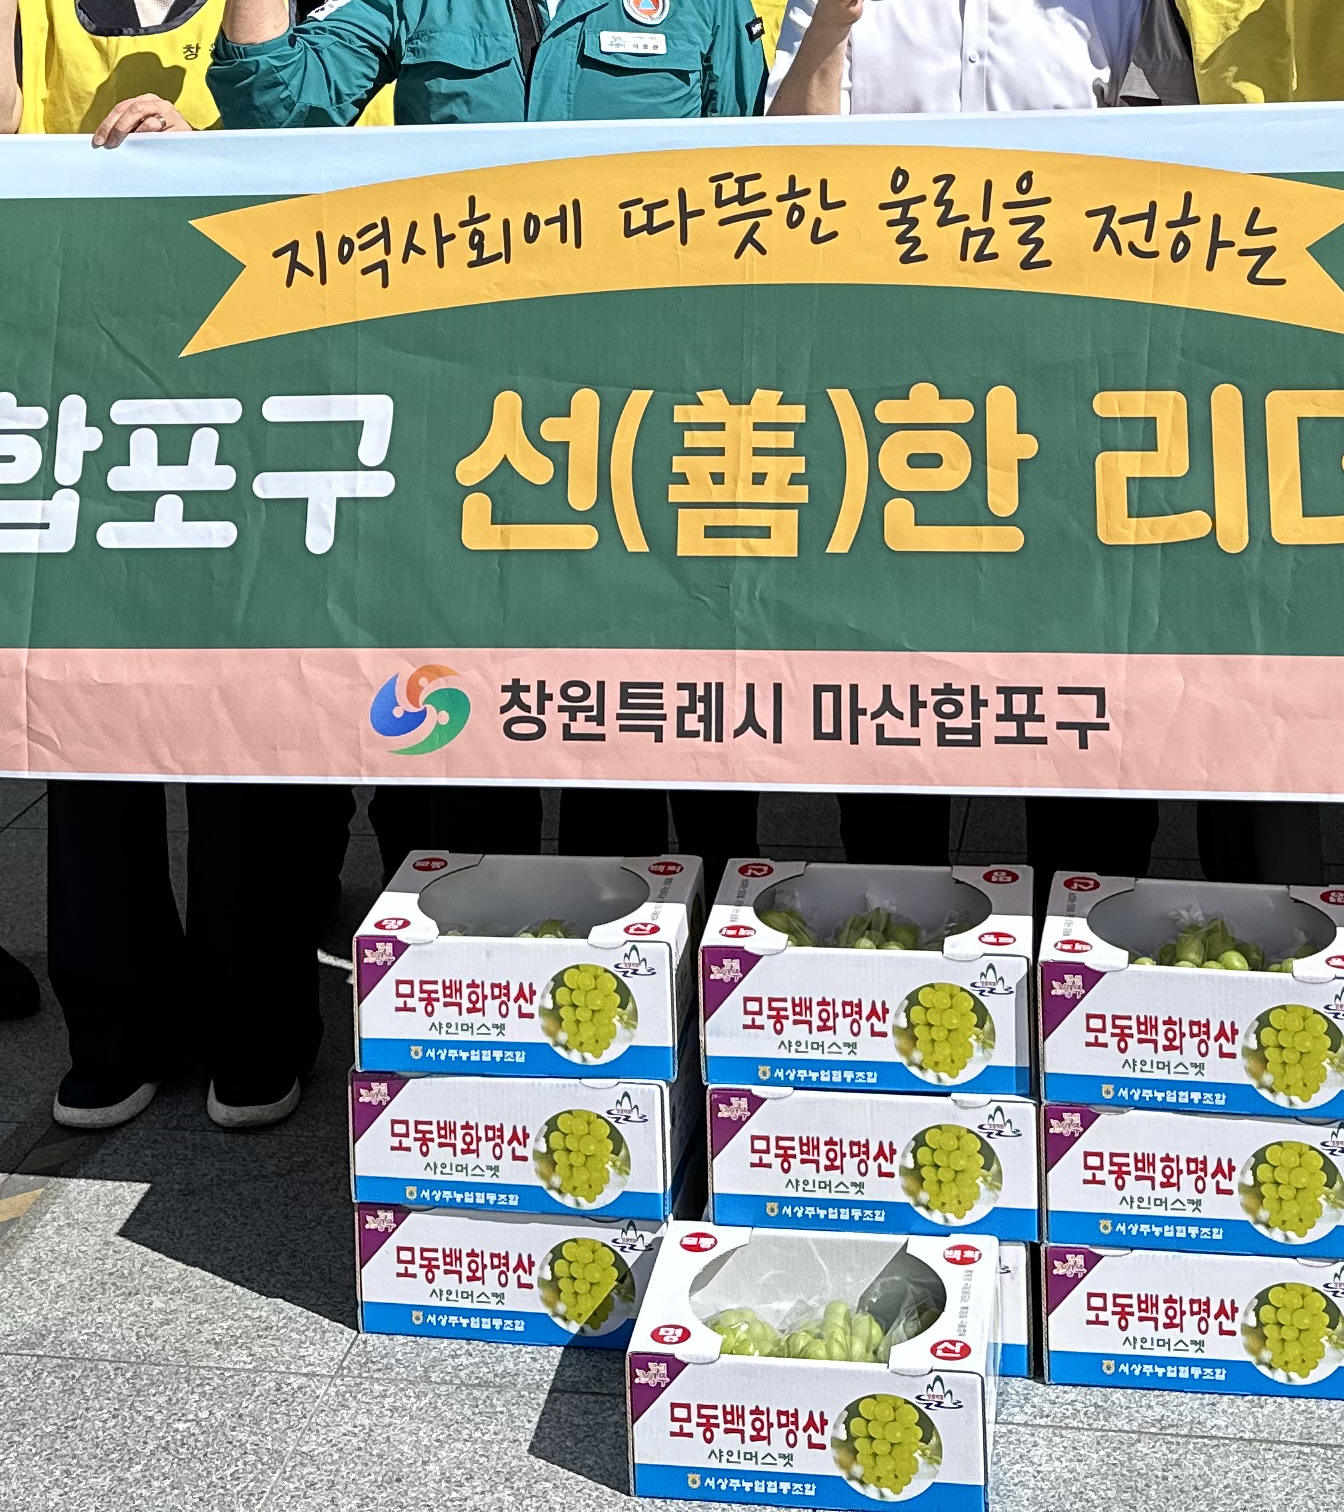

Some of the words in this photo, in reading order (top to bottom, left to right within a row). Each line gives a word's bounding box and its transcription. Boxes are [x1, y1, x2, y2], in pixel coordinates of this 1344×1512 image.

[268, 193, 584, 290] 지역사회에
[618, 169, 850, 260] 따뜻한
[875, 164, 1056, 274] 울림을
[1084, 189, 1288, 290] 전하는
[450, 381, 1043, 559] 선(善)한
[498, 676, 783, 748] 창원특례시
[812, 676, 1112, 752] 마산합포구
[393, 976, 537, 1020] 모동백화명산
[741, 995, 890, 1039] 모동백화명산
[1083, 1012, 1240, 1060] 모동백화명산
[388, 1117, 531, 1163] 모동백화명산
[748, 1133, 898, 1179] 모동백화명산
[1081, 1149, 1237, 1197] 모동백화명산
[395, 1244, 536, 1290] 모동백화명산
[1084, 1291, 1240, 1338] 모동백화명산
[935, 1341, 965, 1358] 산
[668, 1400, 829, 1451] 모동백화명산
